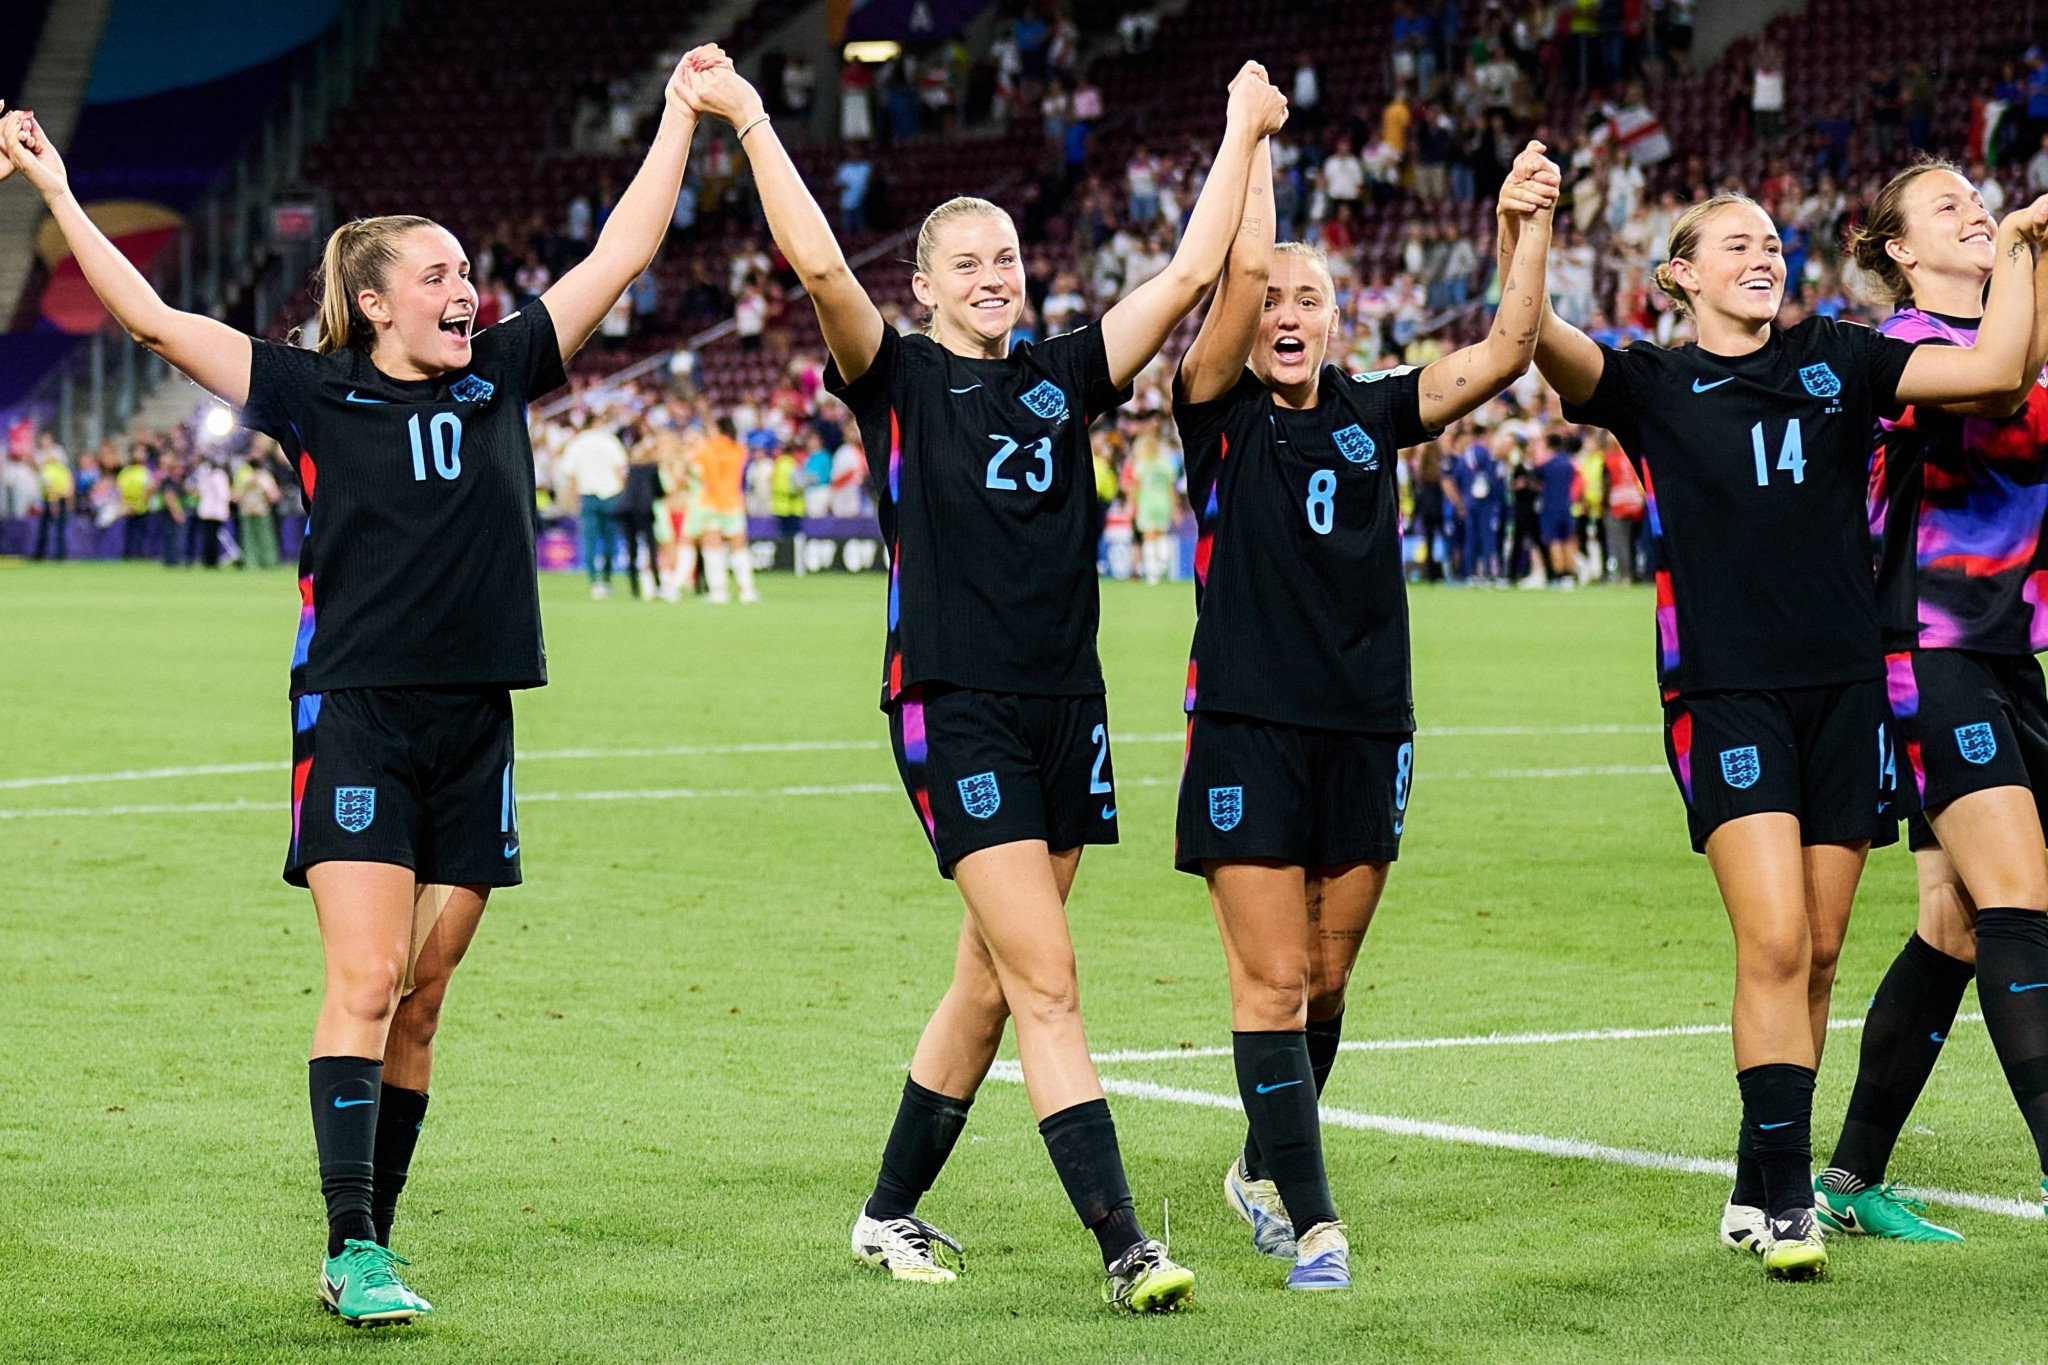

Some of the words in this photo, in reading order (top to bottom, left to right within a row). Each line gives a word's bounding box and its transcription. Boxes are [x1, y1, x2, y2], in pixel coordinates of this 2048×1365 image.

[408, 411, 462, 481] 10
[986, 433, 1053, 493] 23
[1751, 418, 1807, 487] 14
[1306, 469, 1337, 535] 8
[1090, 723, 1112, 794] 2
[1396, 742, 1412, 811] 8
[501, 761, 518, 833] 1
